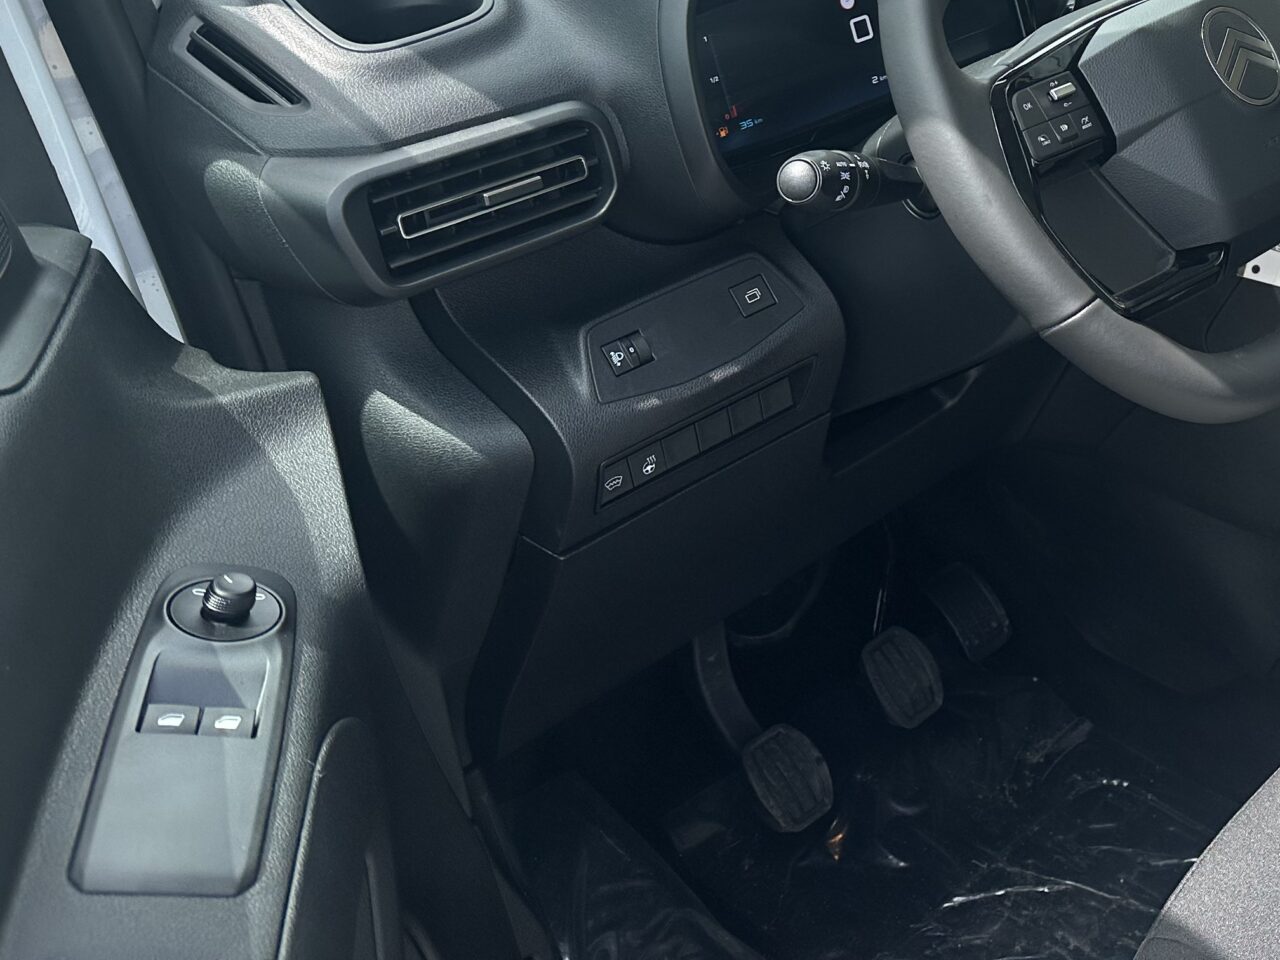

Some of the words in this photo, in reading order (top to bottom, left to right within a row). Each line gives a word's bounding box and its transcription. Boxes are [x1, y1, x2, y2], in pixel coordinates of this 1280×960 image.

[871, 75, 880, 84] 2
[1022, 102, 1033, 111] OK
[739, 119, 754, 130] 35
